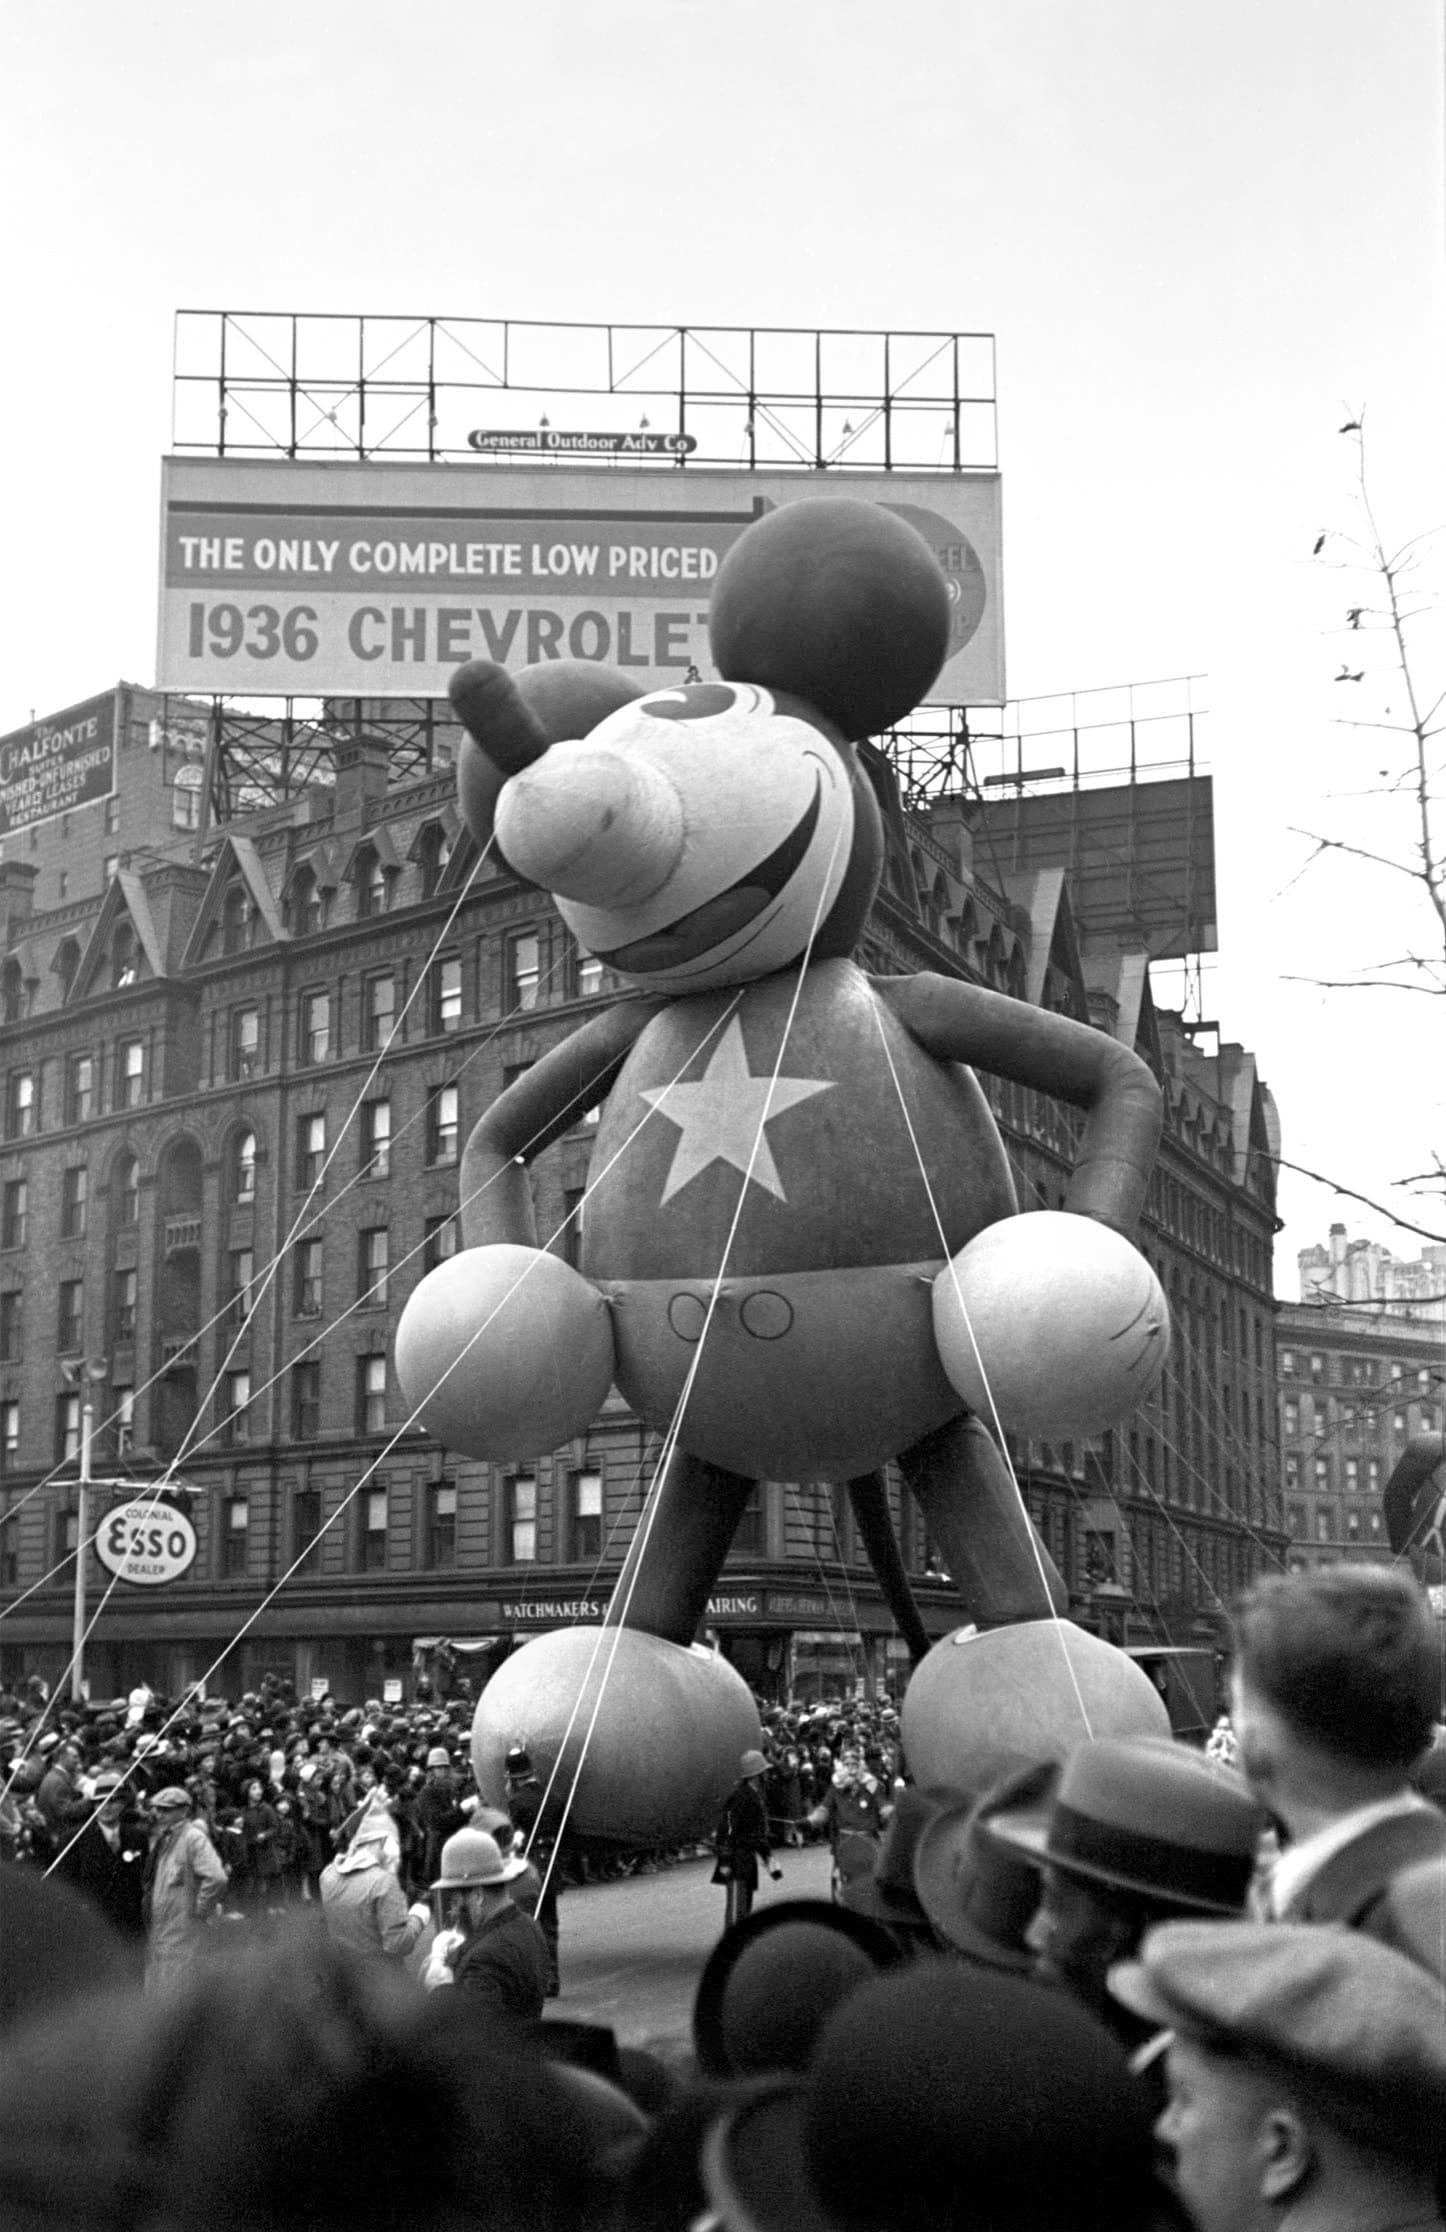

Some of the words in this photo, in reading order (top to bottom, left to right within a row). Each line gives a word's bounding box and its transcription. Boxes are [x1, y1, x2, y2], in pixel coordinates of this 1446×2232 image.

[475, 430, 542, 448] General
[548, 432, 617, 450] Outdoor
[622, 434, 657, 450] Adv
[664, 434, 688, 452] Co
[179, 536, 244, 569] THE
[254, 538, 340, 573] ONLY
[349, 540, 522, 577] COMPLETE
[532, 543, 599, 577] LOW
[608, 546, 718, 579] PRICED
[189, 602, 318, 661] 1936
[348, 606, 711, 667] CHEVROLE
[0, 717, 98, 785] CHALFONTE
[125, 1508, 173, 1521] COLONIAL
[107, 1517, 187, 1559] ESSO
[127, 1563, 166, 1575] DEALER
[503, 1602, 599, 1618] WATCHMAKERS
